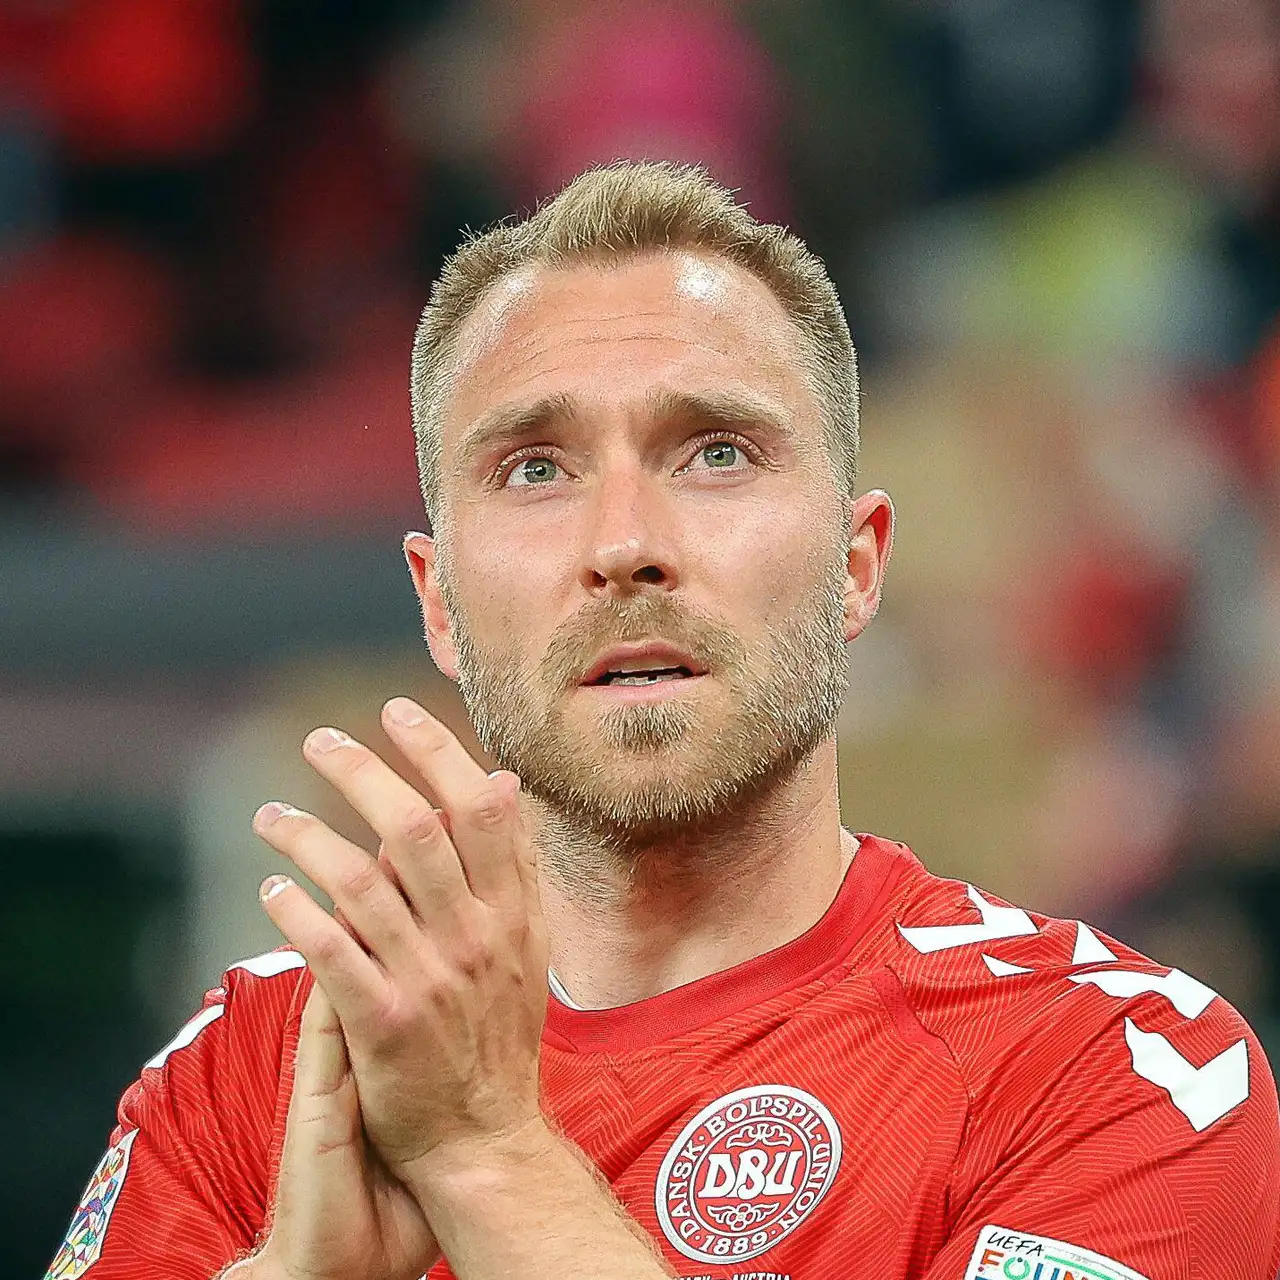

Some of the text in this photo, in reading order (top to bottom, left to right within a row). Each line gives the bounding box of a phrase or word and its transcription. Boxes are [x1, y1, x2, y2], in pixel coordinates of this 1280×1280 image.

[668, 1139, 706, 1240] DANSK
[698, 1148, 804, 1200] DBU
[699, 1231, 770, 1257] 1889
[986, 1231, 1045, 1258] UEFA
